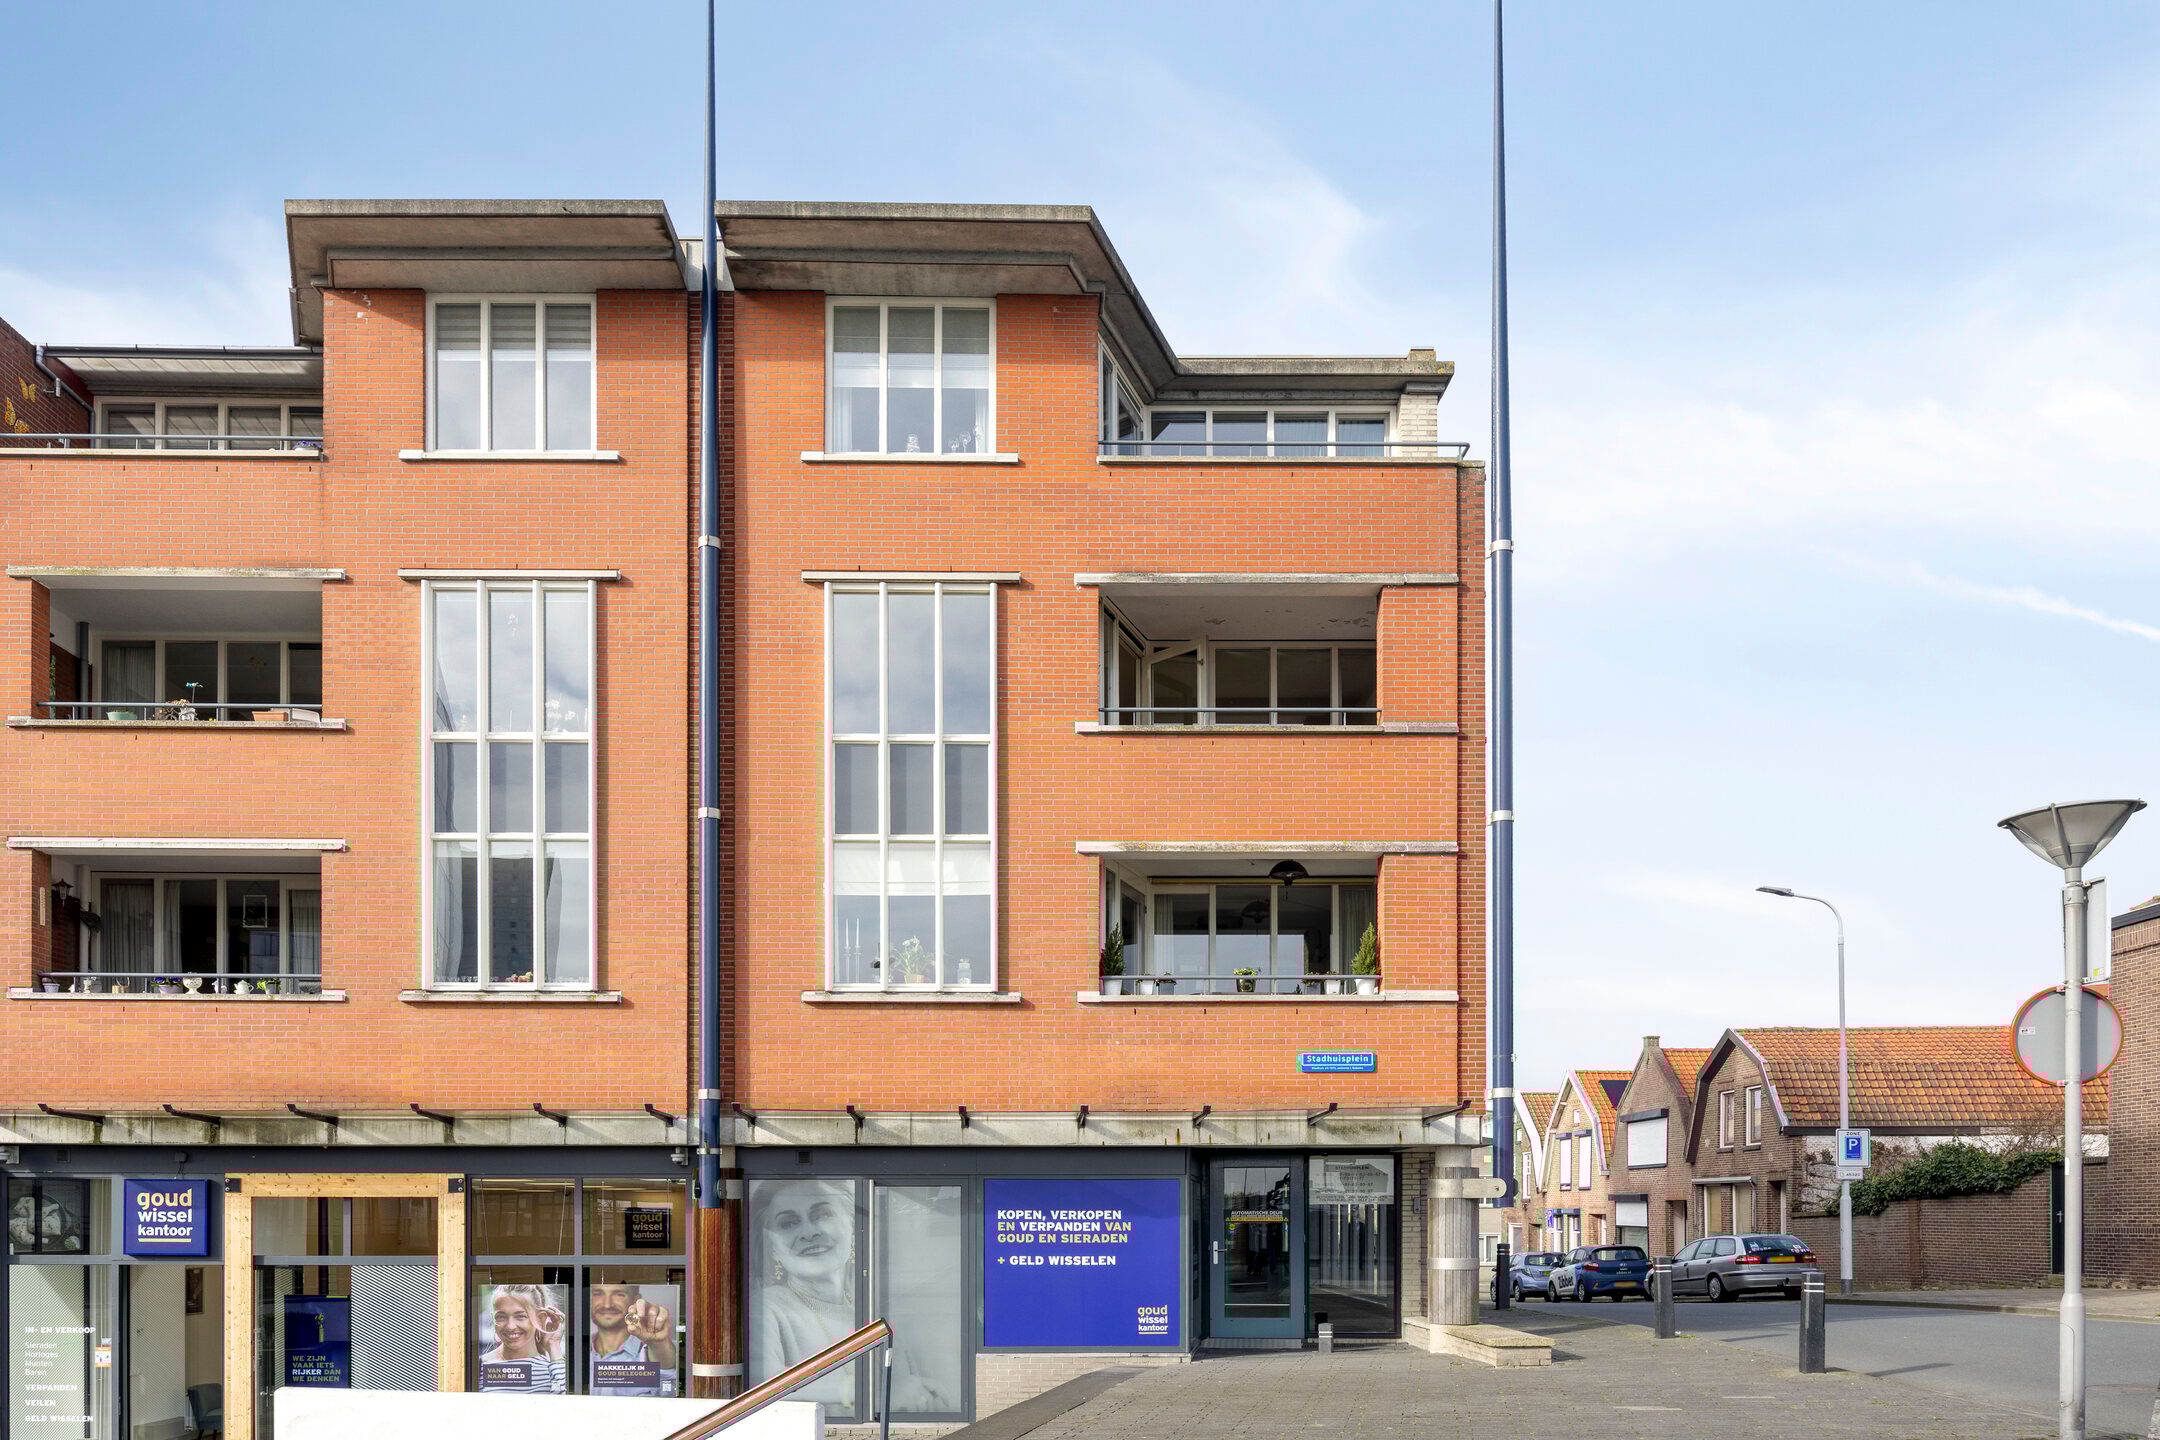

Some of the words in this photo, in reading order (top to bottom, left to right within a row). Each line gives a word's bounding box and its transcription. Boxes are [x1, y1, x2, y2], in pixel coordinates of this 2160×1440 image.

[1307, 1055, 1369, 1063] Stadhuisplein
[137, 1188, 192, 1210] goud
[137, 1207, 193, 1223] wissel
[632, 1212, 663, 1223] goud
[997, 1210, 1046, 1221] KOPEN,
[1050, 1210, 1122, 1220] VERKOPEN
[137, 1223, 194, 1236] kantoor
[632, 1222, 663, 1231] wissel
[997, 1221, 1016, 1232] EN
[1019, 1221, 1101, 1232] VERPANDEN
[1105, 1221, 1132, 1232] VAN
[632, 1231, 664, 1239] kantoor
[997, 1233, 1035, 1244] GOUD
[1038, 1233, 1057, 1244] EN
[1060, 1233, 1128, 1244] SIERADEN
[1009, 1255, 1045, 1266] GELD
[1048, 1255, 1117, 1266] WISSELEN
[1558, 1274, 1574, 1289] Zibber
[1137, 1304, 1168, 1317] goud
[1138, 1315, 1168, 1324] wissel
[40, 1326, 53, 1334] EN
[55, 1326, 96, 1334] VERKOOP
[1138, 1324, 1169, 1332] kantoor
[25, 1351, 59, 1359] Horloges
